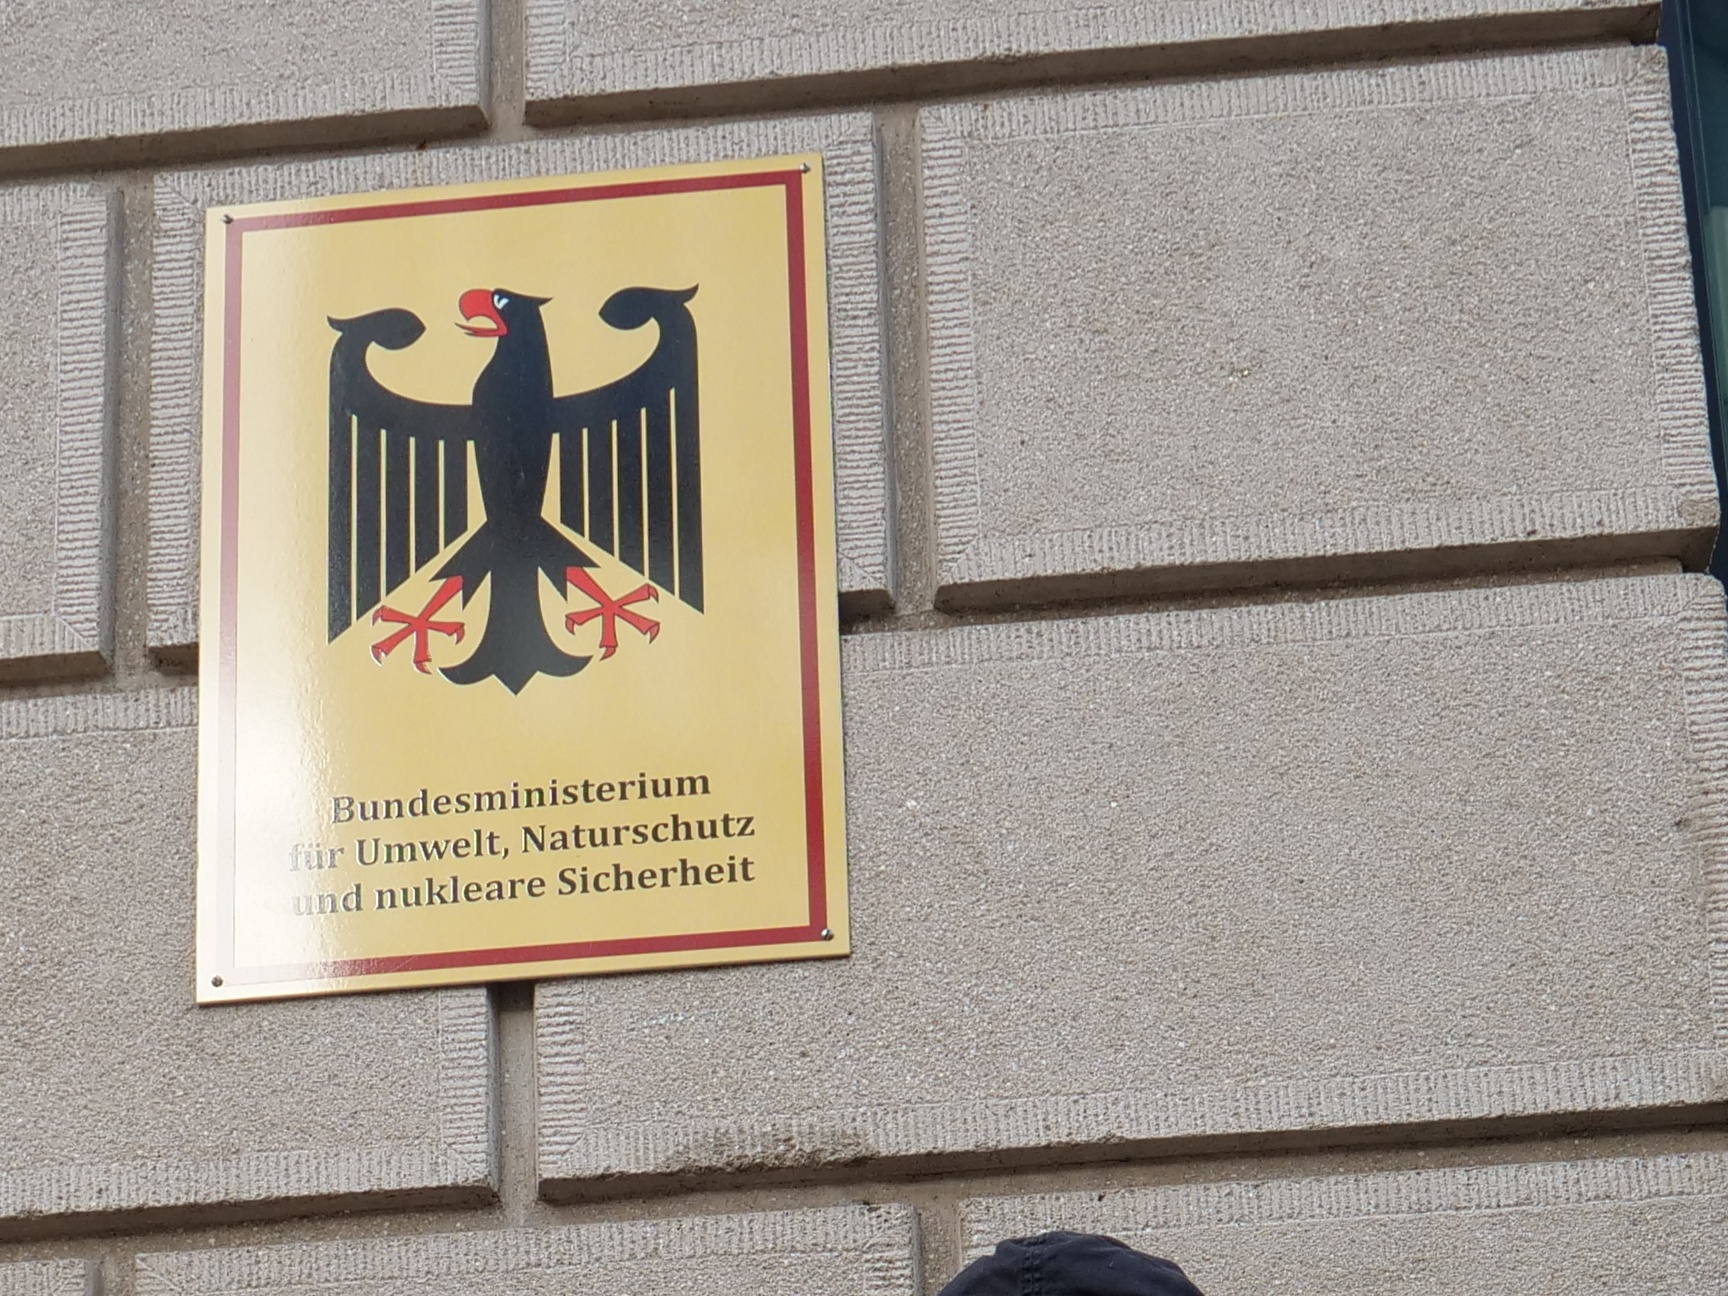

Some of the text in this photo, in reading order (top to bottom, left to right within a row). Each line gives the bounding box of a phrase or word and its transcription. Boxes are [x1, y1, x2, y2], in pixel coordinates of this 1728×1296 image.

[330, 770, 712, 825] Bundesministerium
[288, 809, 756, 873] für Umwelt, Naturschutz
[291, 854, 756, 917] und nukleare Sicherheit
